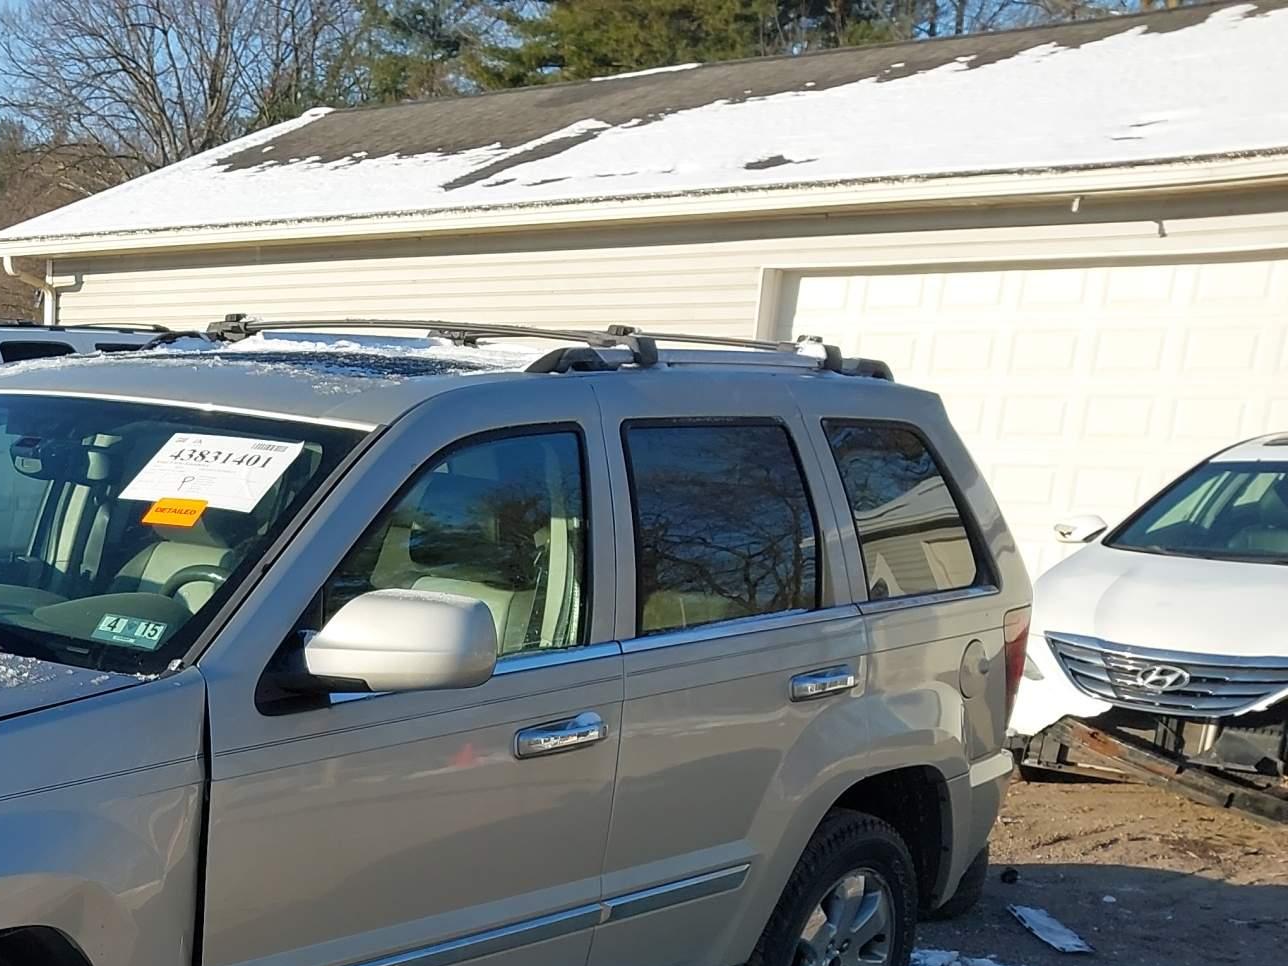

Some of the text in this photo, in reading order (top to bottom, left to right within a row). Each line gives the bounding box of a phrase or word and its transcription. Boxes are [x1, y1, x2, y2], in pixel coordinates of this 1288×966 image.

[169, 448, 273, 468] 43831401
[154, 506, 197, 516] DETAILED
[107, 617, 161, 638] 4 15
